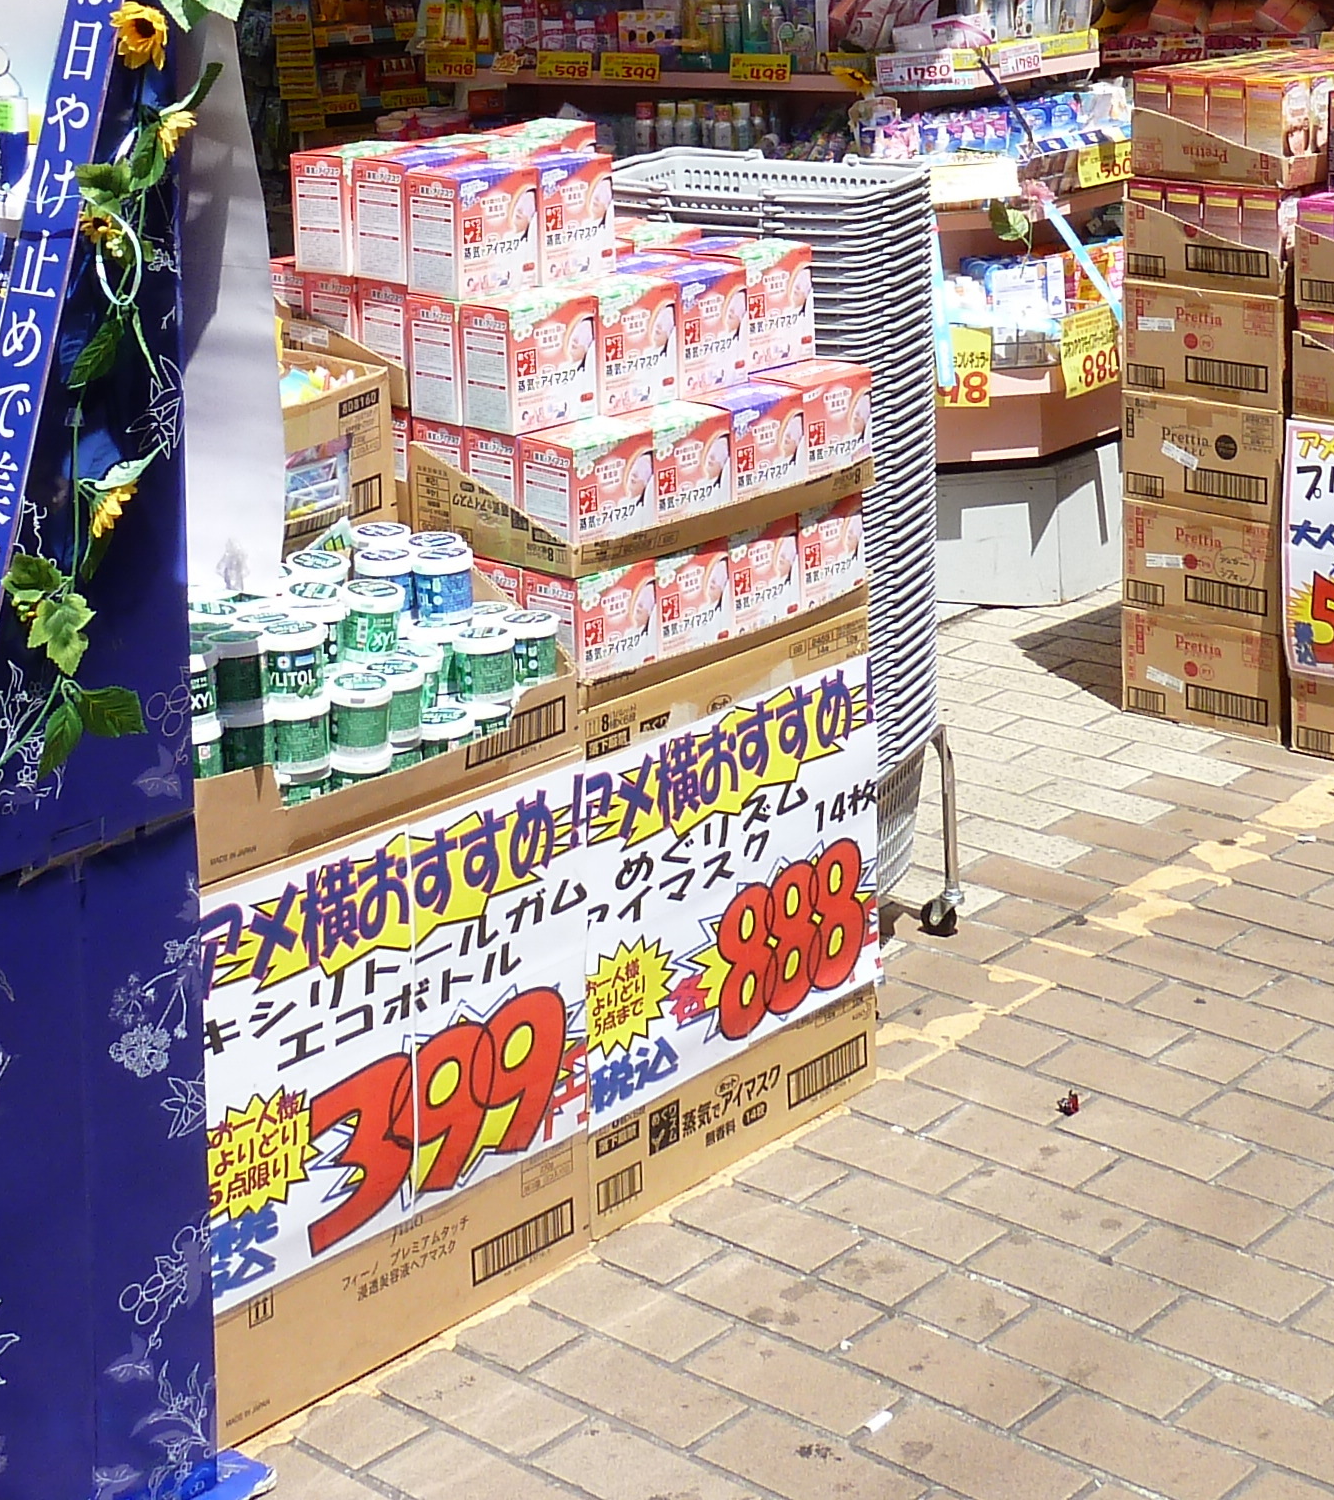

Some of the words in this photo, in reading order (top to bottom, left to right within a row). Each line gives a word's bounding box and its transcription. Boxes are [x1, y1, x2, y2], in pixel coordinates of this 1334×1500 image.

[1161, 425, 1209, 447] Prettia
[1174, 525, 1223, 550] Prettia
[1174, 633, 1223, 659] Prettia
[586, 829, 771, 932] アイマスク
[717, 837, 865, 1041] 888
[279, 941, 522, 1072] エコボトル
[308, 984, 569, 1258] 399
